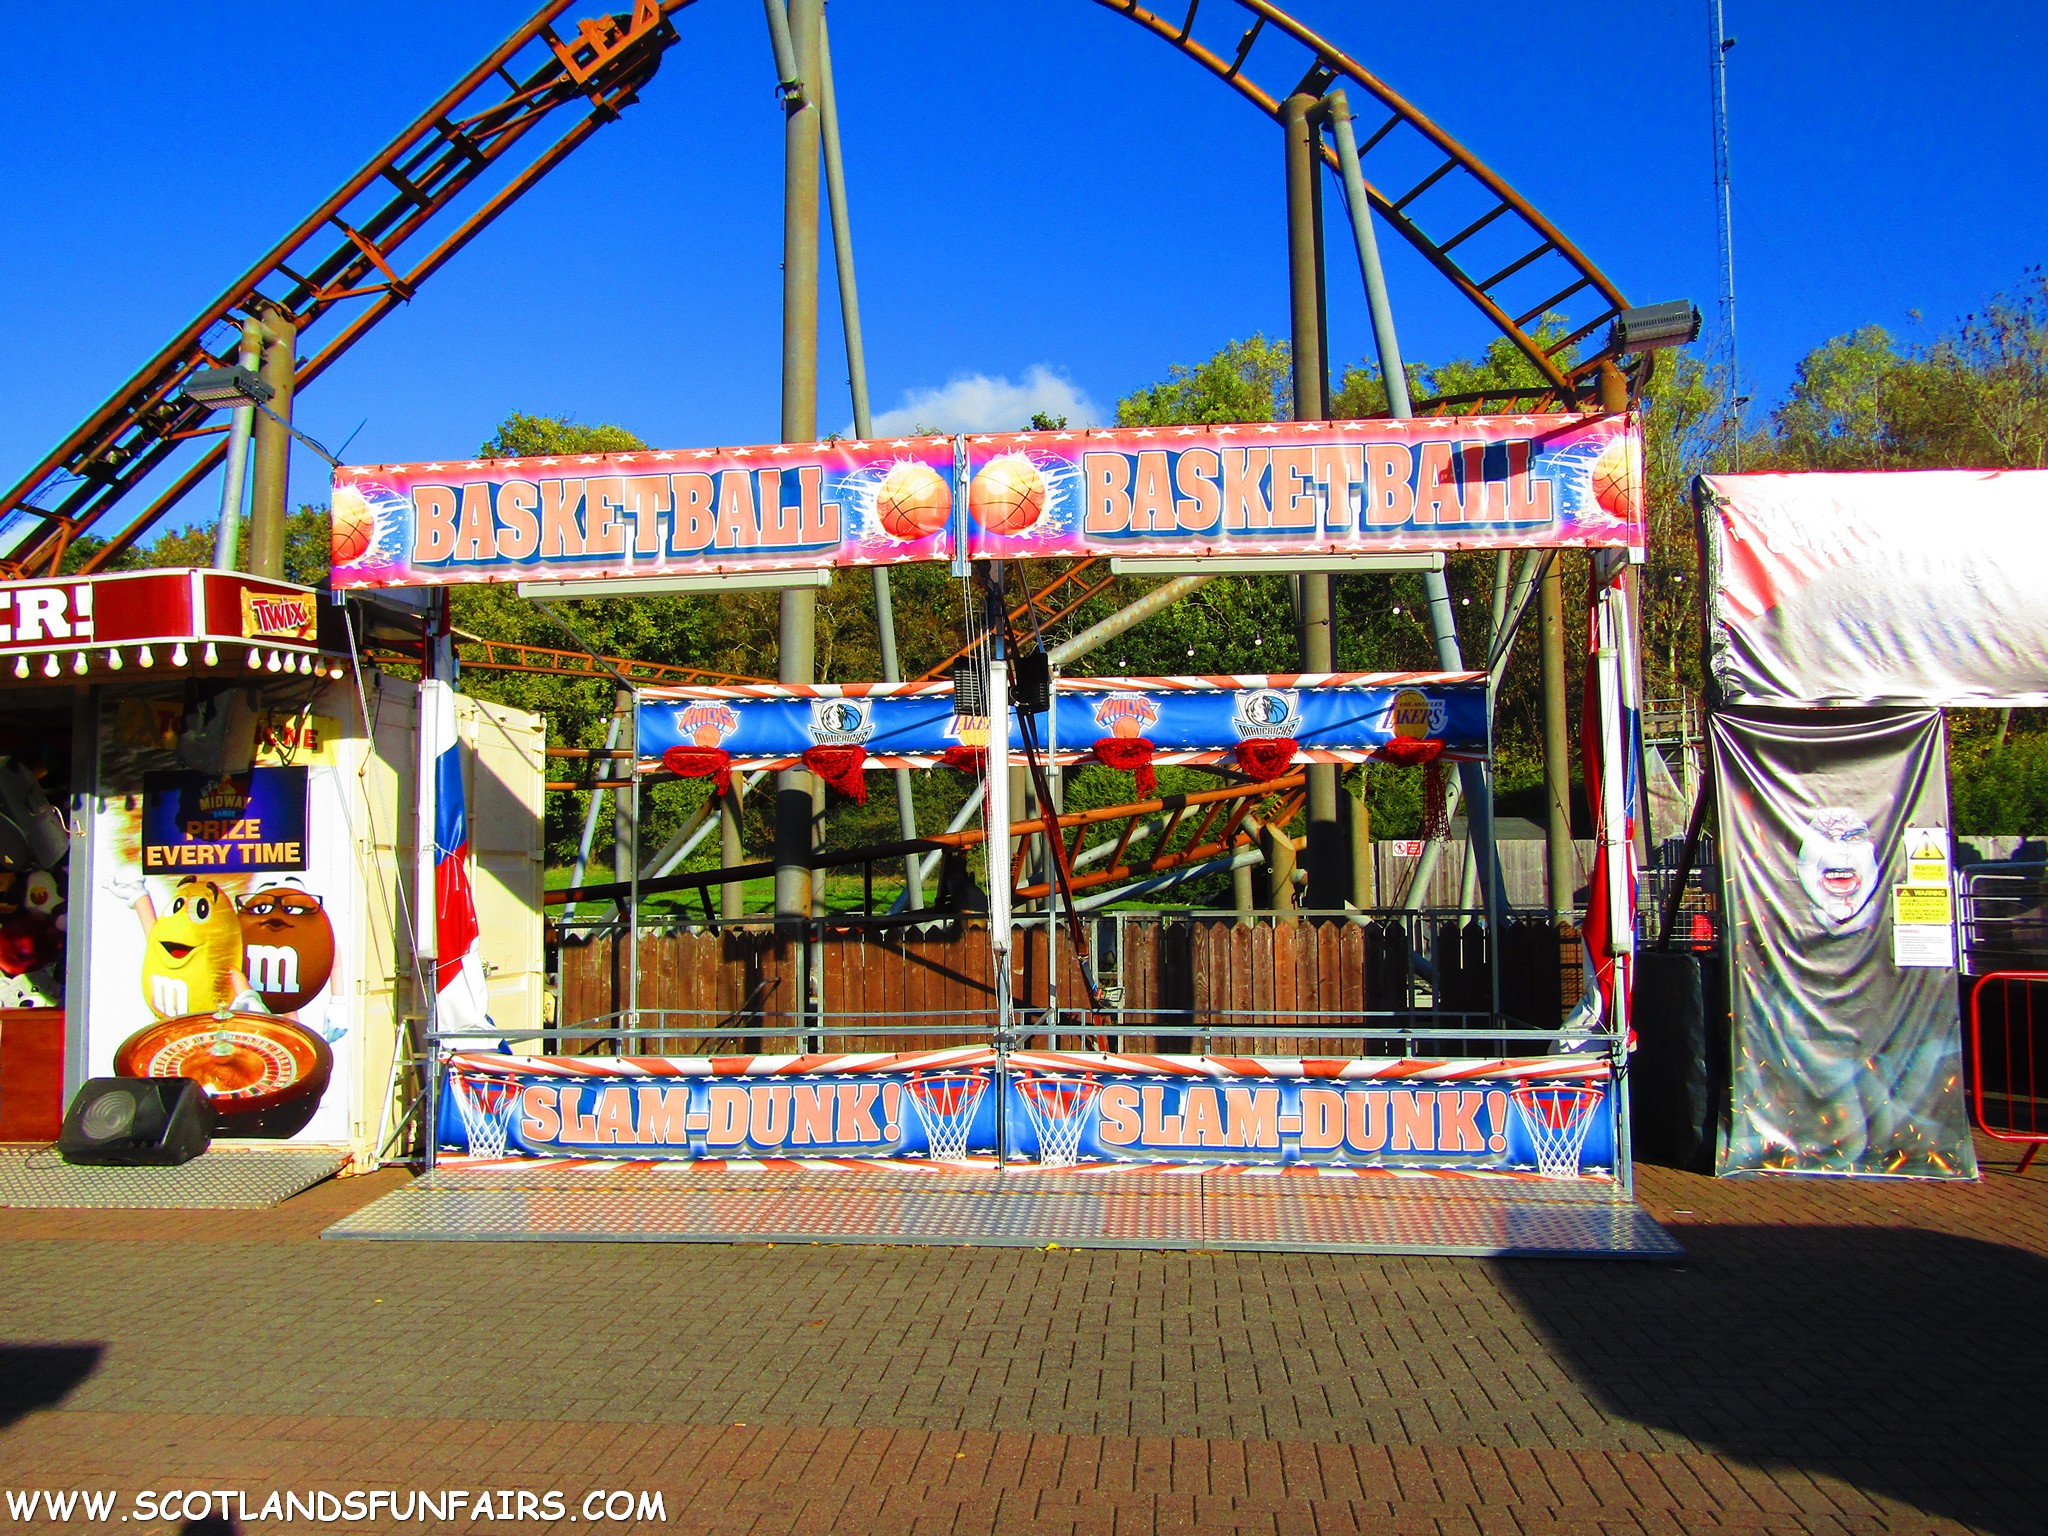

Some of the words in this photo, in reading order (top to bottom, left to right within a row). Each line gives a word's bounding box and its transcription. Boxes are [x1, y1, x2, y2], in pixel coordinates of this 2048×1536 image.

[1082, 439, 1554, 535] BASKETBALL
[411, 465, 842, 566] BASKETBALL
[0, 585, 92, 641] R!
[679, 706, 737, 730] KNICKS
[1096, 697, 1156, 721] KNICKS
[1380, 702, 1443, 731] LAKERS
[814, 731, 869, 746] MAVERICKS
[1238, 723, 1296, 738] MAVERICKS
[199, 796, 252, 811] MIDWAY
[186, 819, 261, 840] PRIZE
[147, 844, 231, 867] EVERY
[238, 842, 301, 864] TIME
[246, 944, 300, 993] m
[521, 1081, 901, 1146] SLAM-DUNK!
[1100, 1084, 1508, 1153] SLAM-DUNK!
